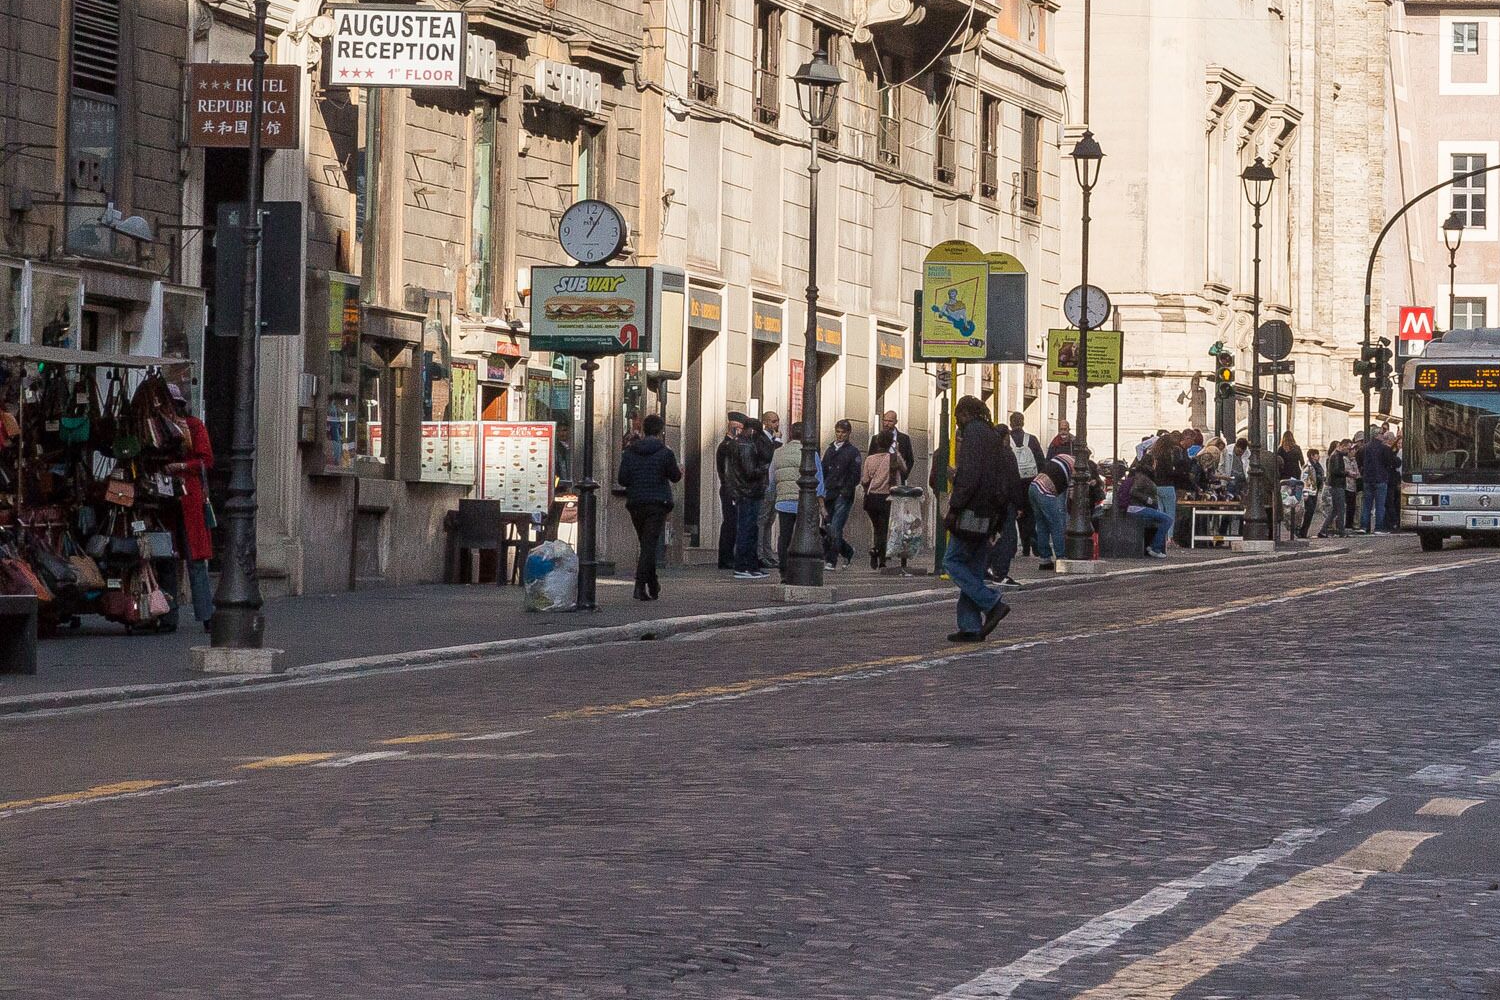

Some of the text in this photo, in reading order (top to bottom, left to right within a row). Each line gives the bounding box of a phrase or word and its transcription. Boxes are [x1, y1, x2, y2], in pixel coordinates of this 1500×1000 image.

[338, 14, 456, 39] AUGUSTEA
[337, 41, 455, 61] RECEPTION
[405, 69, 453, 81] FLOOR
[198, 99, 286, 114] REPUBBICA
[201, 120, 282, 135] 共和国馆
[586, 204, 598, 215] 12
[563, 227, 571, 236] 9
[611, 227, 619, 237] 3
[586, 249, 593, 259] 6
[554, 274, 626, 294] SUBWAY
[1402, 312, 1432, 334] M
[1418, 368, 1438, 388] 40
